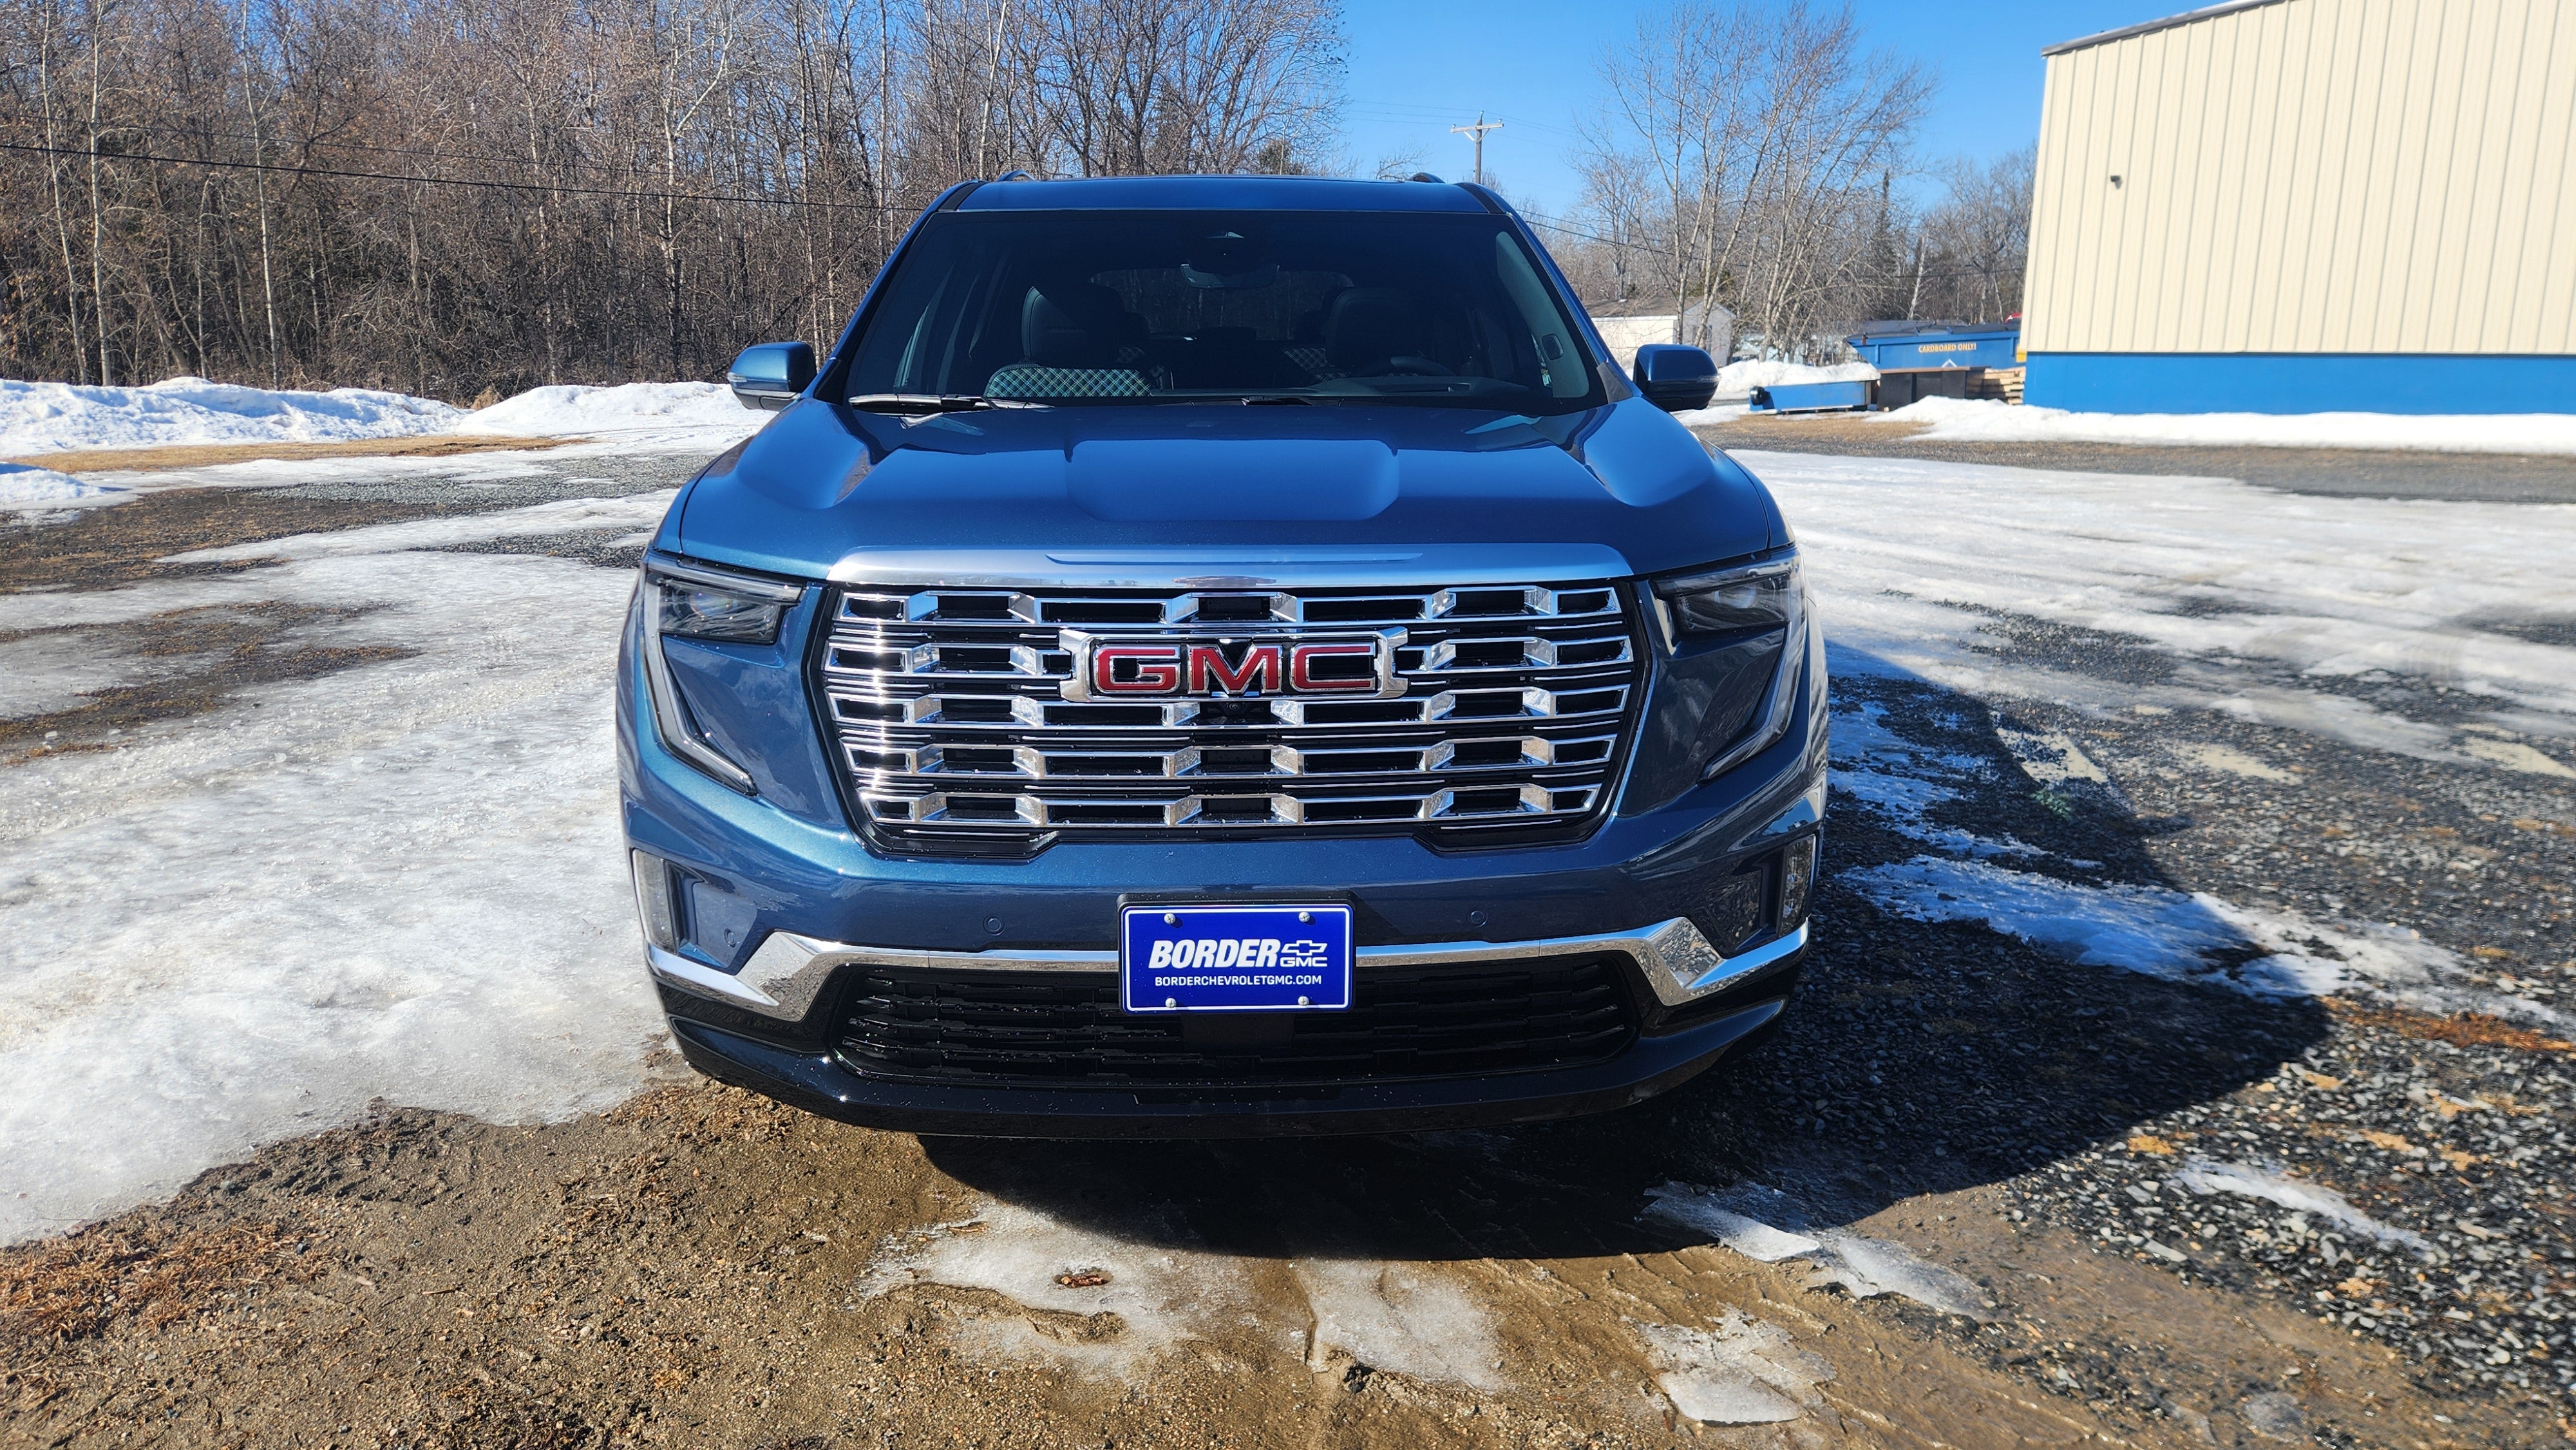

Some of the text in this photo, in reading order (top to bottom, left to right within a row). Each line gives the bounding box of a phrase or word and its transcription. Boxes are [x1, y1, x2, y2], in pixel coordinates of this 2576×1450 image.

[1918, 343, 1976, 353] CARDBOARD ONLY!
[1095, 644, 1377, 694] GMC
[1148, 939, 1281, 968] BORDER
[1280, 957, 1327, 967] GMC
[1155, 975, 1321, 986] BORDERCHEVROLETGMC.COM
